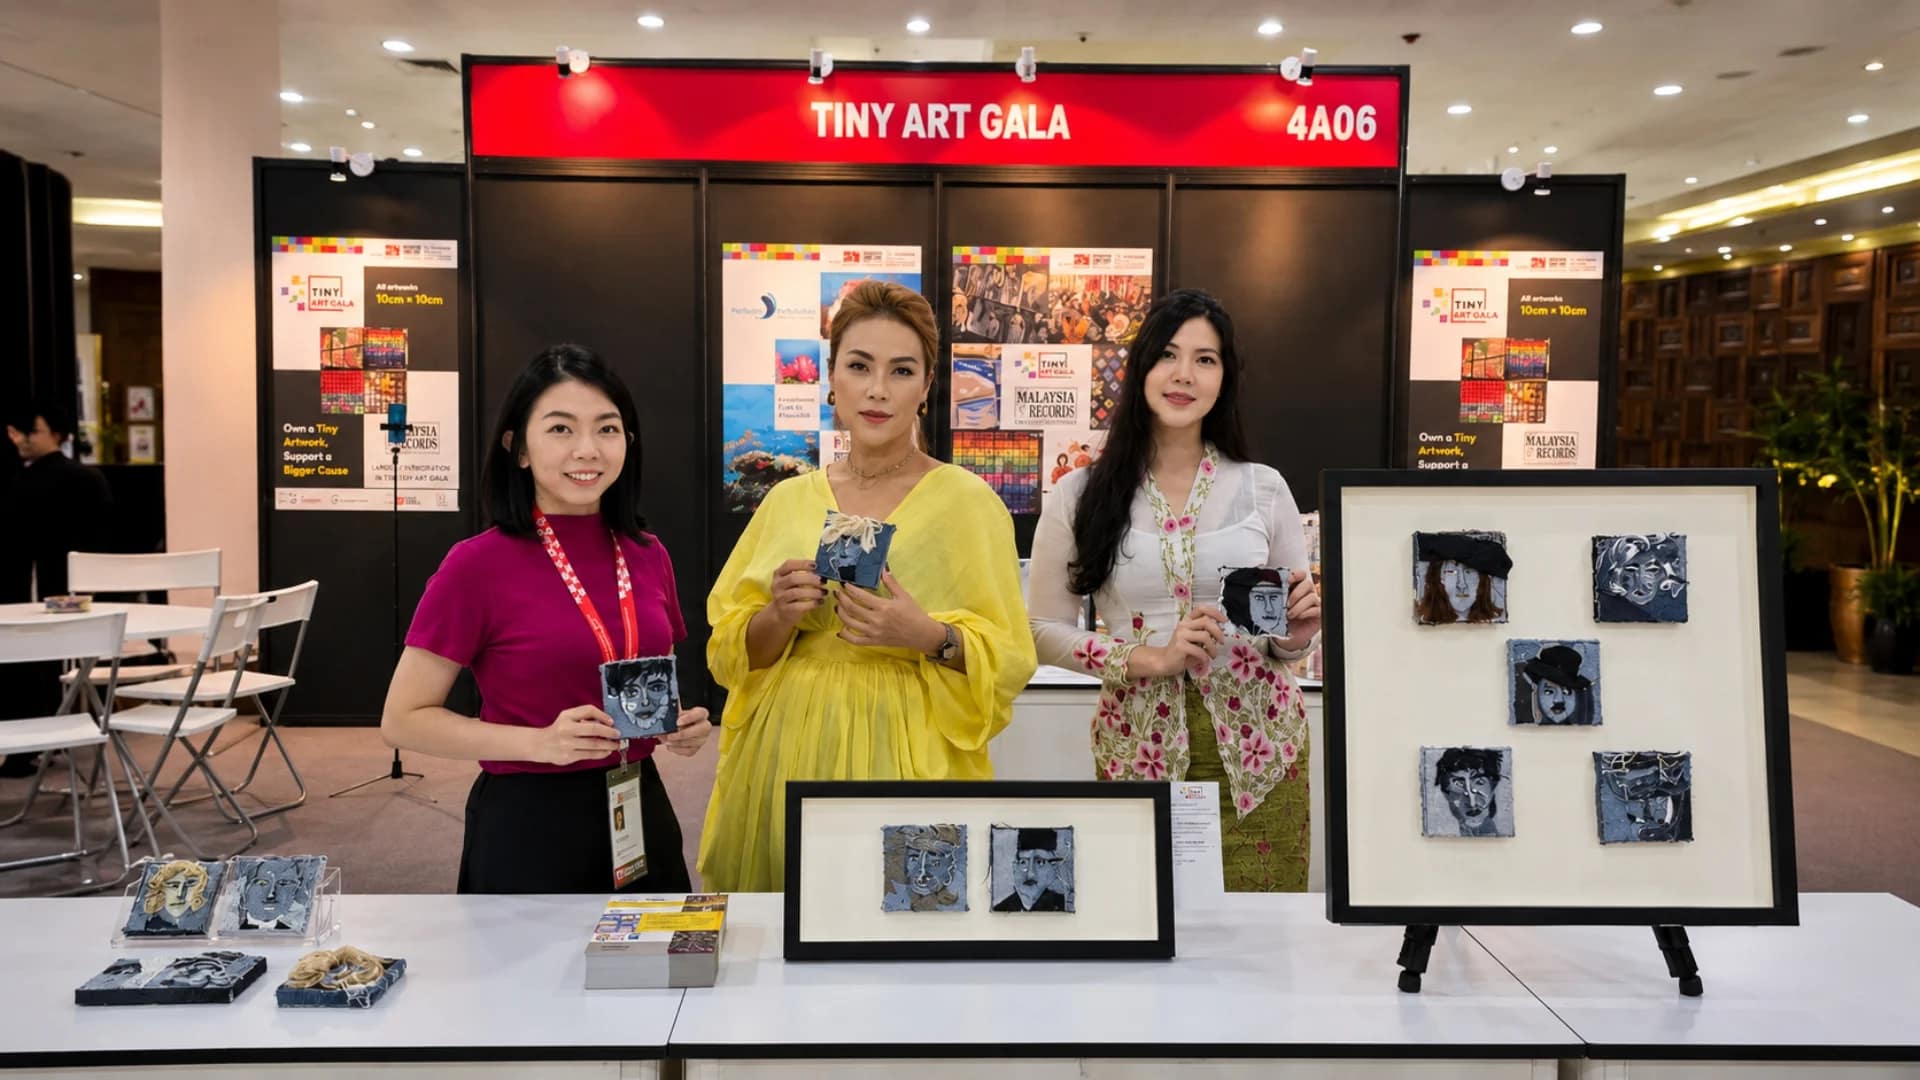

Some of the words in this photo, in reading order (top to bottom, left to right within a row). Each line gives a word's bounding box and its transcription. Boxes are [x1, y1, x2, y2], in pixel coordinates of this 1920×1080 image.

[811, 102, 895, 139] TINY
[901, 103, 972, 139] ART
[979, 103, 1071, 140] GALA
[1286, 104, 1377, 141] 4A06
[311, 287, 340, 297] TINY
[376, 283, 386, 291] All
[387, 283, 418, 291] artworks
[375, 294, 404, 305] 10cm
[415, 294, 443, 305] 10cm
[1454, 300, 1483, 309] TINY
[1532, 295, 1563, 303] artworks
[1454, 311, 1471, 319] ART
[1473, 311, 1499, 319] GALA
[1520, 304, 1549, 316] 10cm
[1559, 304, 1587, 316] 10cm
[1041, 360, 1065, 368] TINY
[1016, 391, 1075, 403] MALAYSIA
[1029, 404, 1075, 418] RECORDS
[283, 423, 307, 433] Own
[316, 423, 338, 435] Tiny
[283, 437, 328, 448] Artwork,
[1418, 432, 1444, 442] Own
[1445, 434, 1453, 442] a
[1454, 432, 1477, 445] Tiny
[1525, 435, 1576, 446] MALAYSIA
[283, 451, 323, 463] Support
[1418, 446, 1464, 457] Artwork,
[1536, 447, 1577, 459] RECORDS
[1417, 459, 1460, 470] Support
[283, 465, 315, 477] Bigger
[317, 465, 349, 475] Cause
